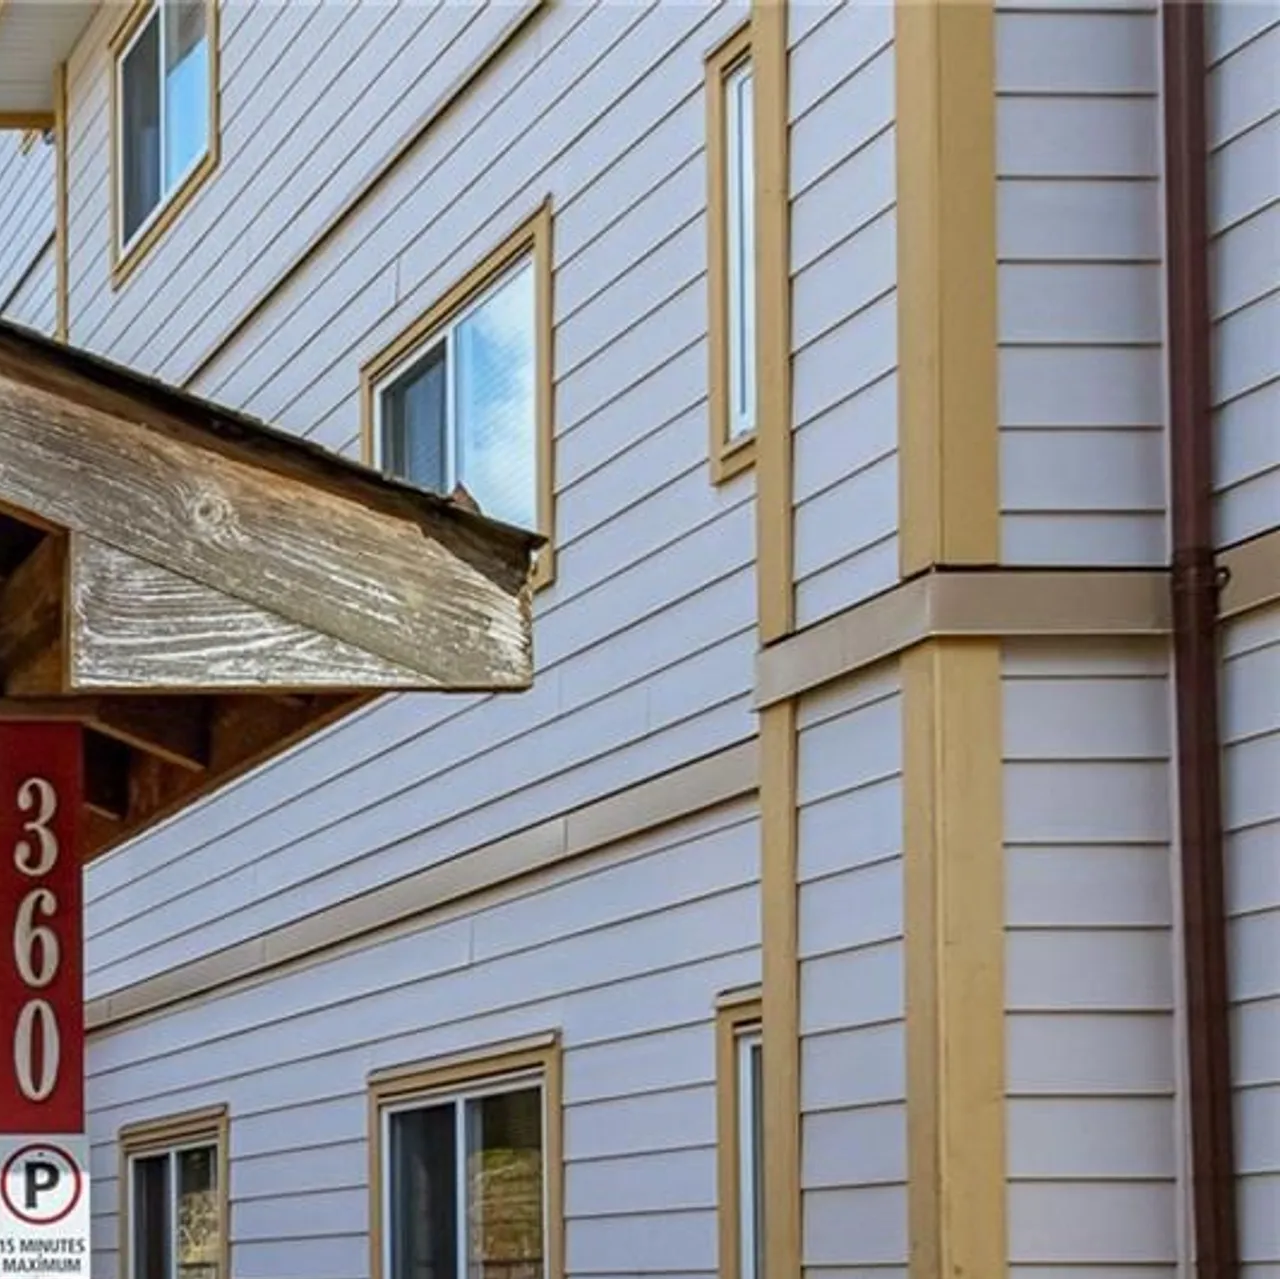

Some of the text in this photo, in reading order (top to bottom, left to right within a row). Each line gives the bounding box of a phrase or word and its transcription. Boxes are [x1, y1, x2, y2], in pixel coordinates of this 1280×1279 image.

[13, 777, 60, 1102] 360
[24, 1161, 60, 1209] P
[0, 1239, 86, 1253] 15 MINUTES
[2, 1258, 82, 1273] MAXIMUM
